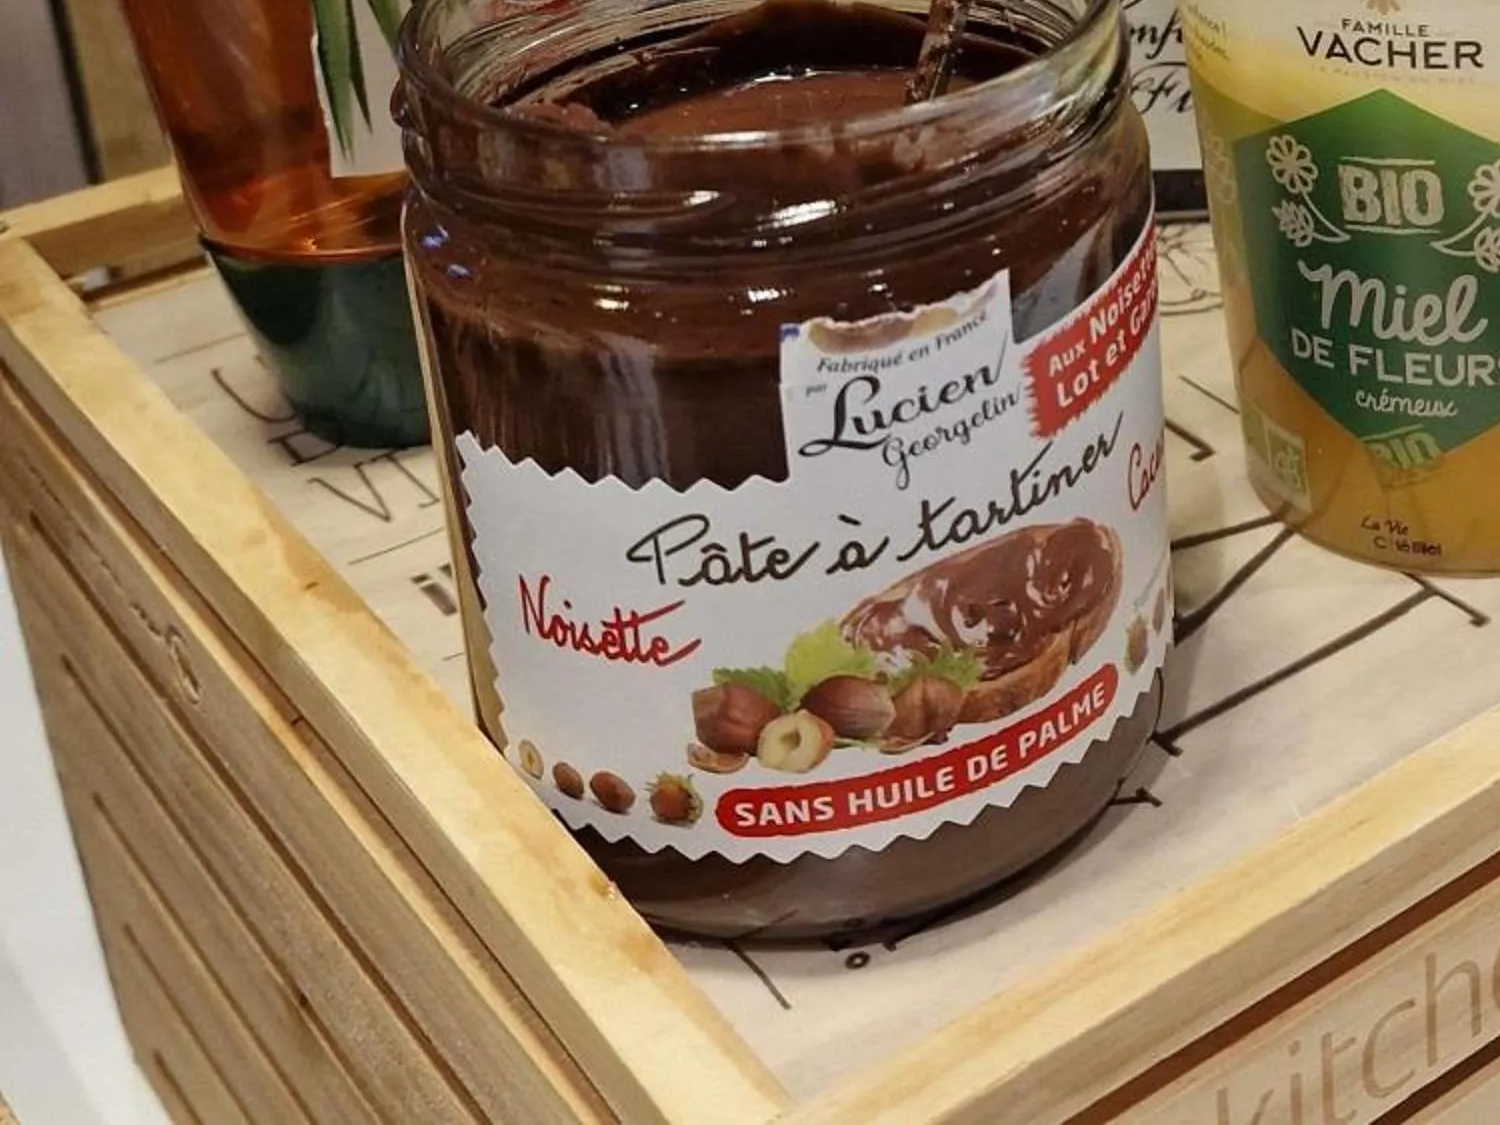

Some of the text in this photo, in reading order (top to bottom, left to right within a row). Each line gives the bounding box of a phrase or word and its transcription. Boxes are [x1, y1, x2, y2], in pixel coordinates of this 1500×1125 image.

[1296, 26, 1485, 70] VACHER
[1341, 18, 1430, 38] FAMILLE
[1338, 165, 1445, 227] BIO
[1297, 258, 1489, 347] Miel
[816, 309, 988, 375] Fabriqué en France
[1049, 337, 1087, 378] Aux
[1055, 357, 1101, 409] Lot
[1104, 328, 1127, 367] et
[1290, 327, 1335, 369] DE
[798, 329, 1008, 458] Lucien
[1354, 388, 1459, 418] crémeux
[880, 380, 1022, 492] Georgelin
[626, 411, 1122, 588] Pâte à tartiner
[518, 572, 702, 668] Noisette
[734, 679, 1107, 830] SANS HUILE DE PALME
